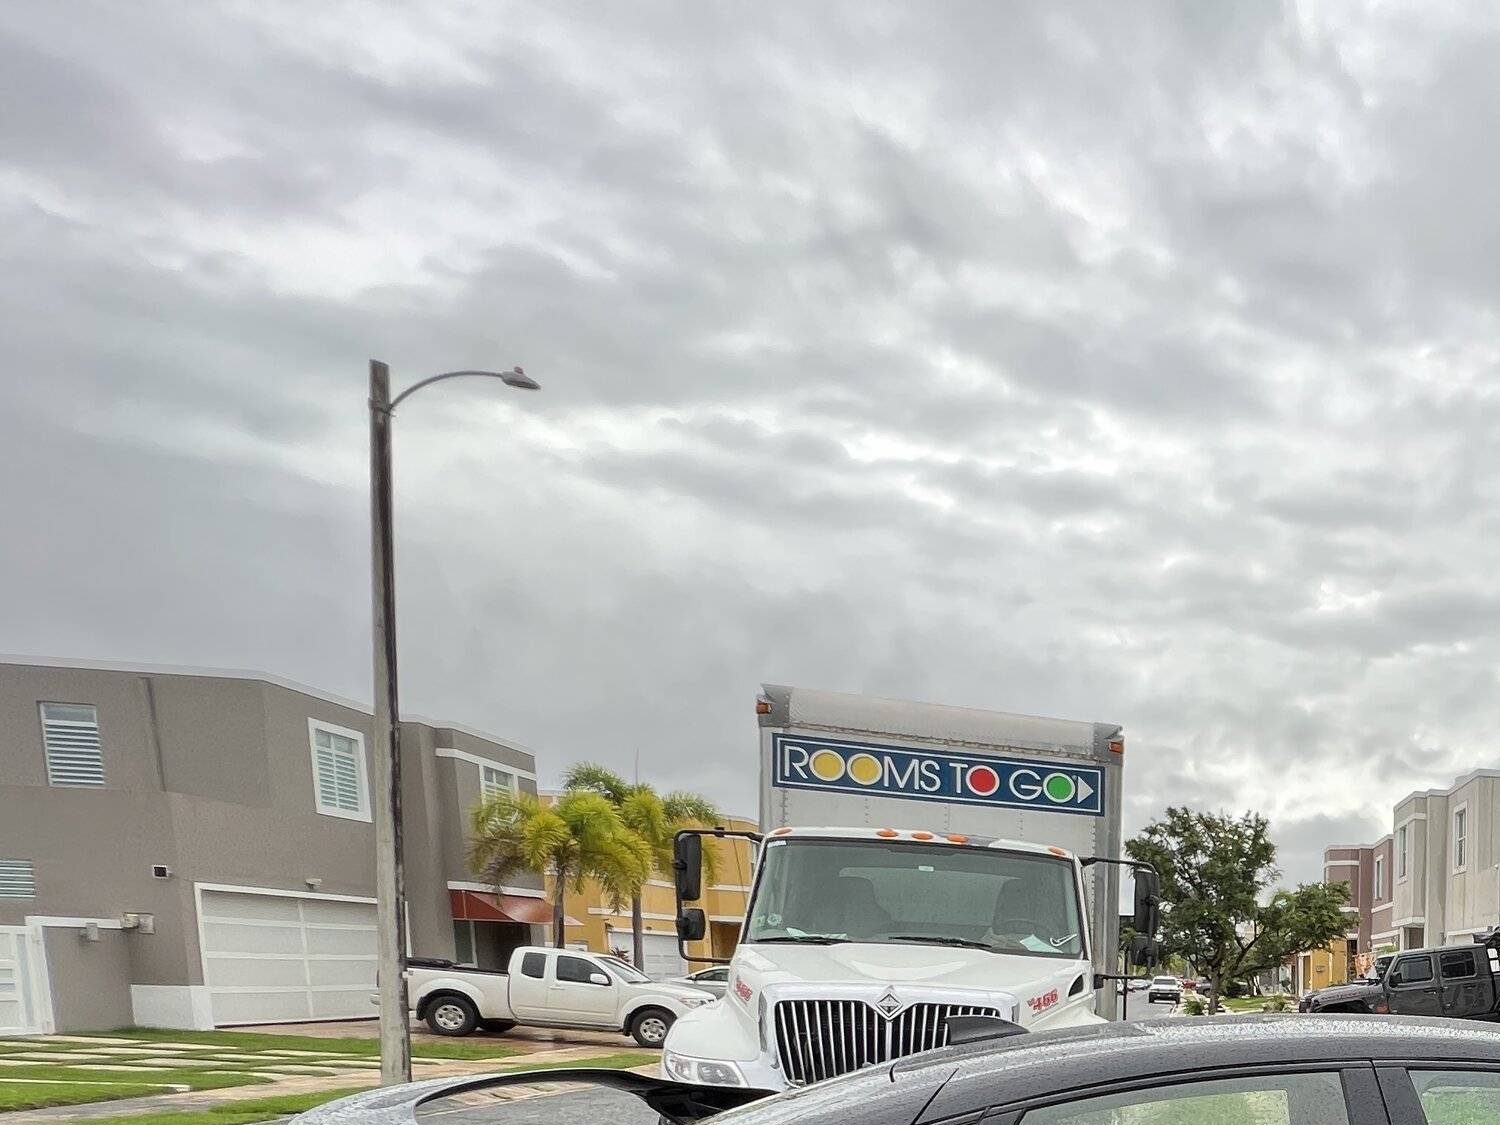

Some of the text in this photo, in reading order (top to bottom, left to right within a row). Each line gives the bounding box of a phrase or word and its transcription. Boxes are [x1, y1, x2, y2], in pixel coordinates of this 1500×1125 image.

[784, 745, 1075, 803] ROOMS TO GO
